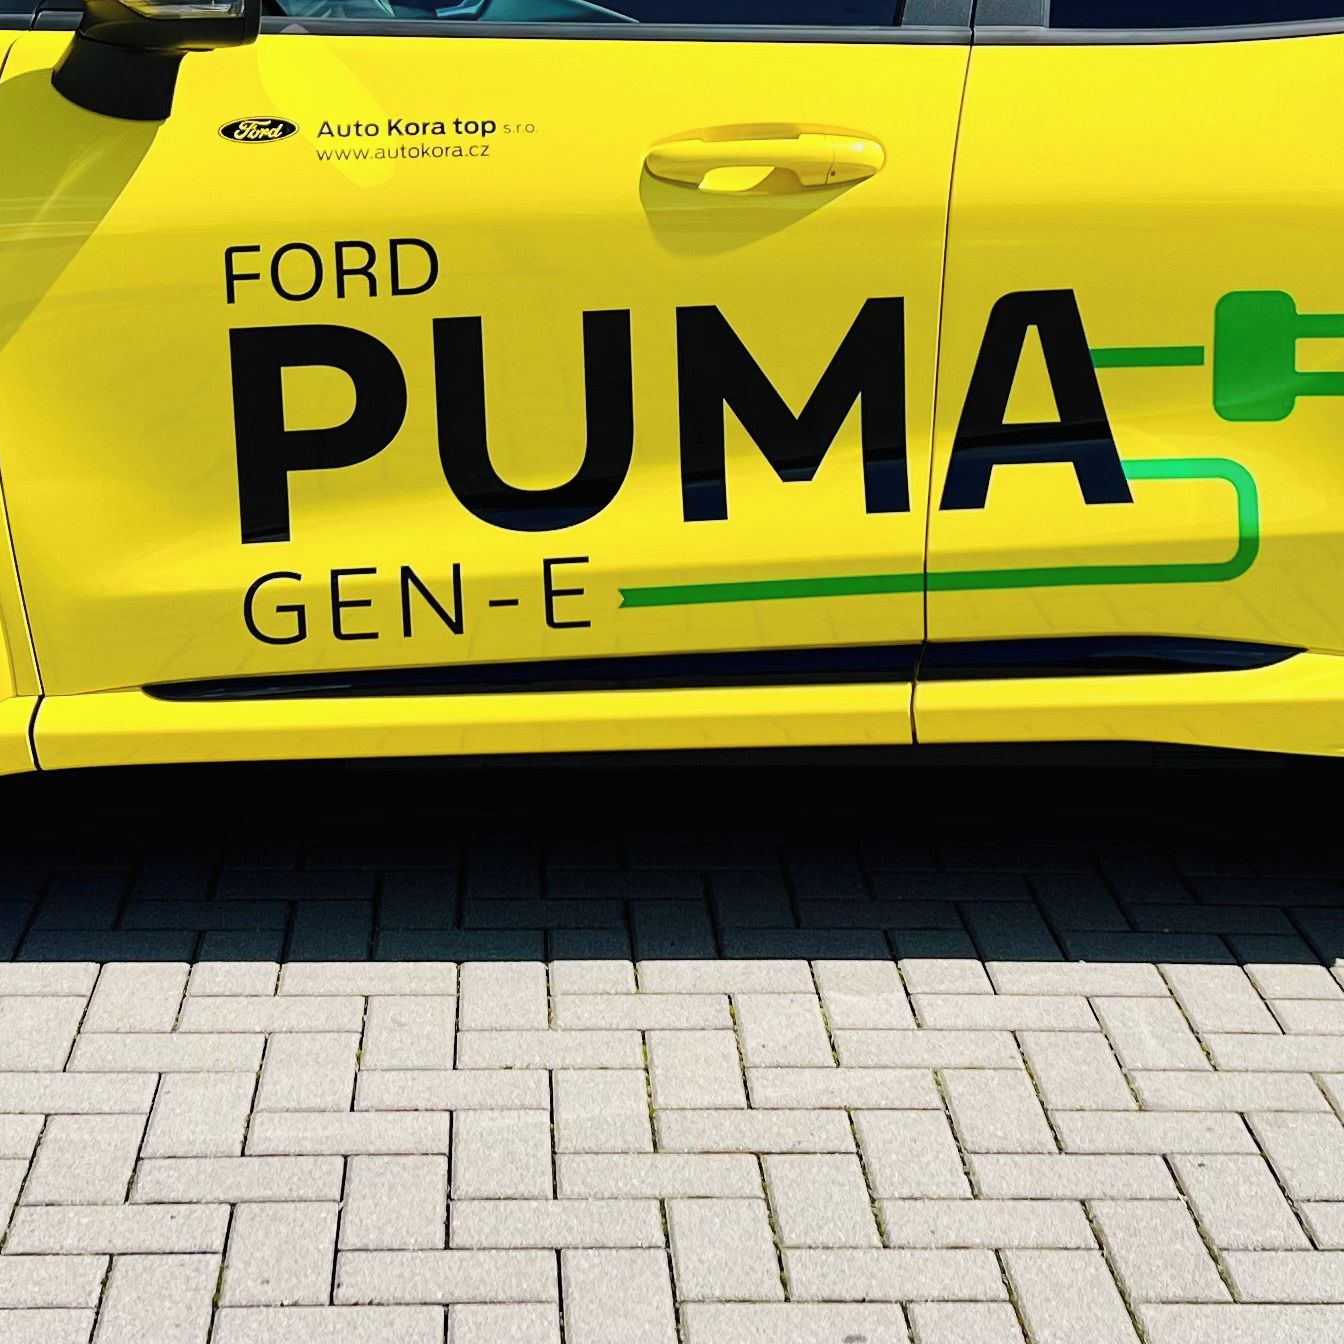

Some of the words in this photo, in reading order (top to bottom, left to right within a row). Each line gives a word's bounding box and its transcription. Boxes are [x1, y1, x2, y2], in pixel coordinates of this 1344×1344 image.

[232, 120, 284, 141] Ford
[316, 120, 380, 139] Auto
[387, 118, 447, 137] Kora
[453, 118, 497, 139] top
[503, 121, 539, 135] s.r.o.
[315, 143, 490, 162] www.autokora.cz
[224, 236, 441, 305] FORD
[227, 288, 1135, 546] PUMA
[242, 555, 593, 647] GEN-E
